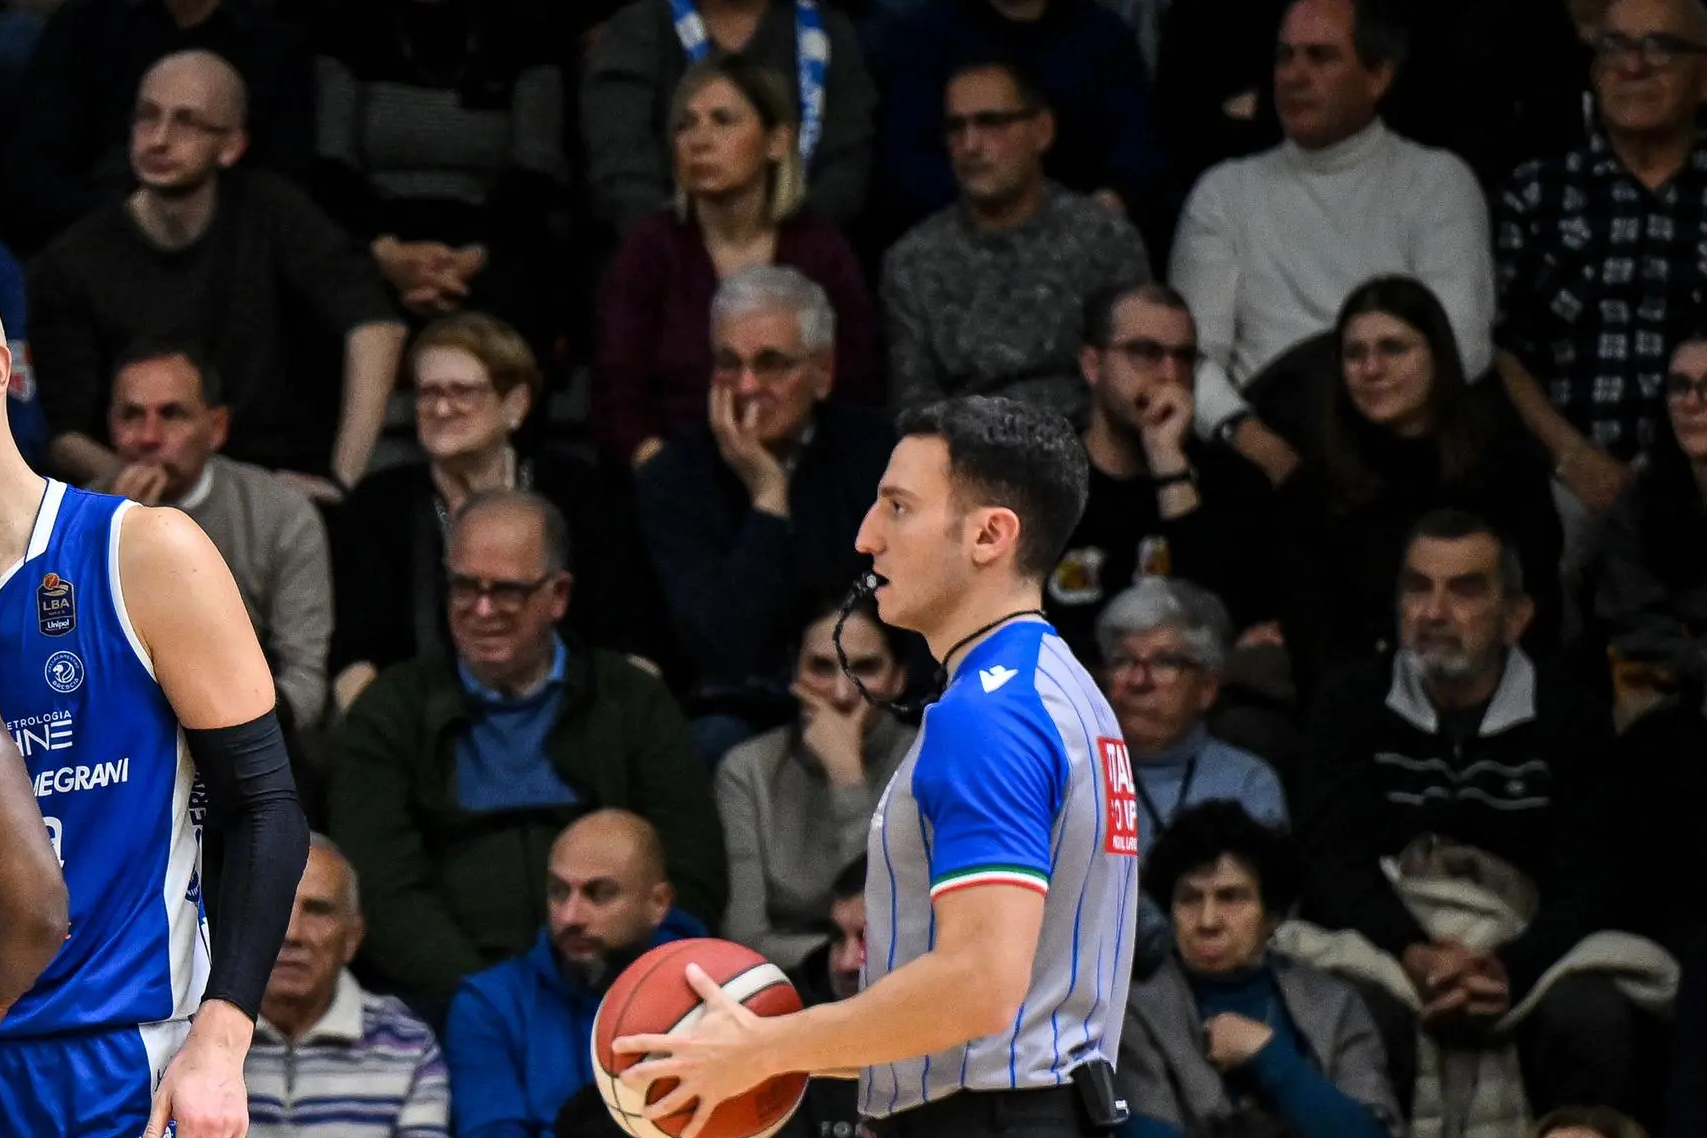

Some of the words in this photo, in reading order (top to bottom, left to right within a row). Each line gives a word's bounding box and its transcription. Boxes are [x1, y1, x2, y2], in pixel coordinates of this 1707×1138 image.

[42, 598, 71, 611] LBA
[46, 619, 71, 630] Unipol
[6, 710, 72, 731] ETROLOGIA
